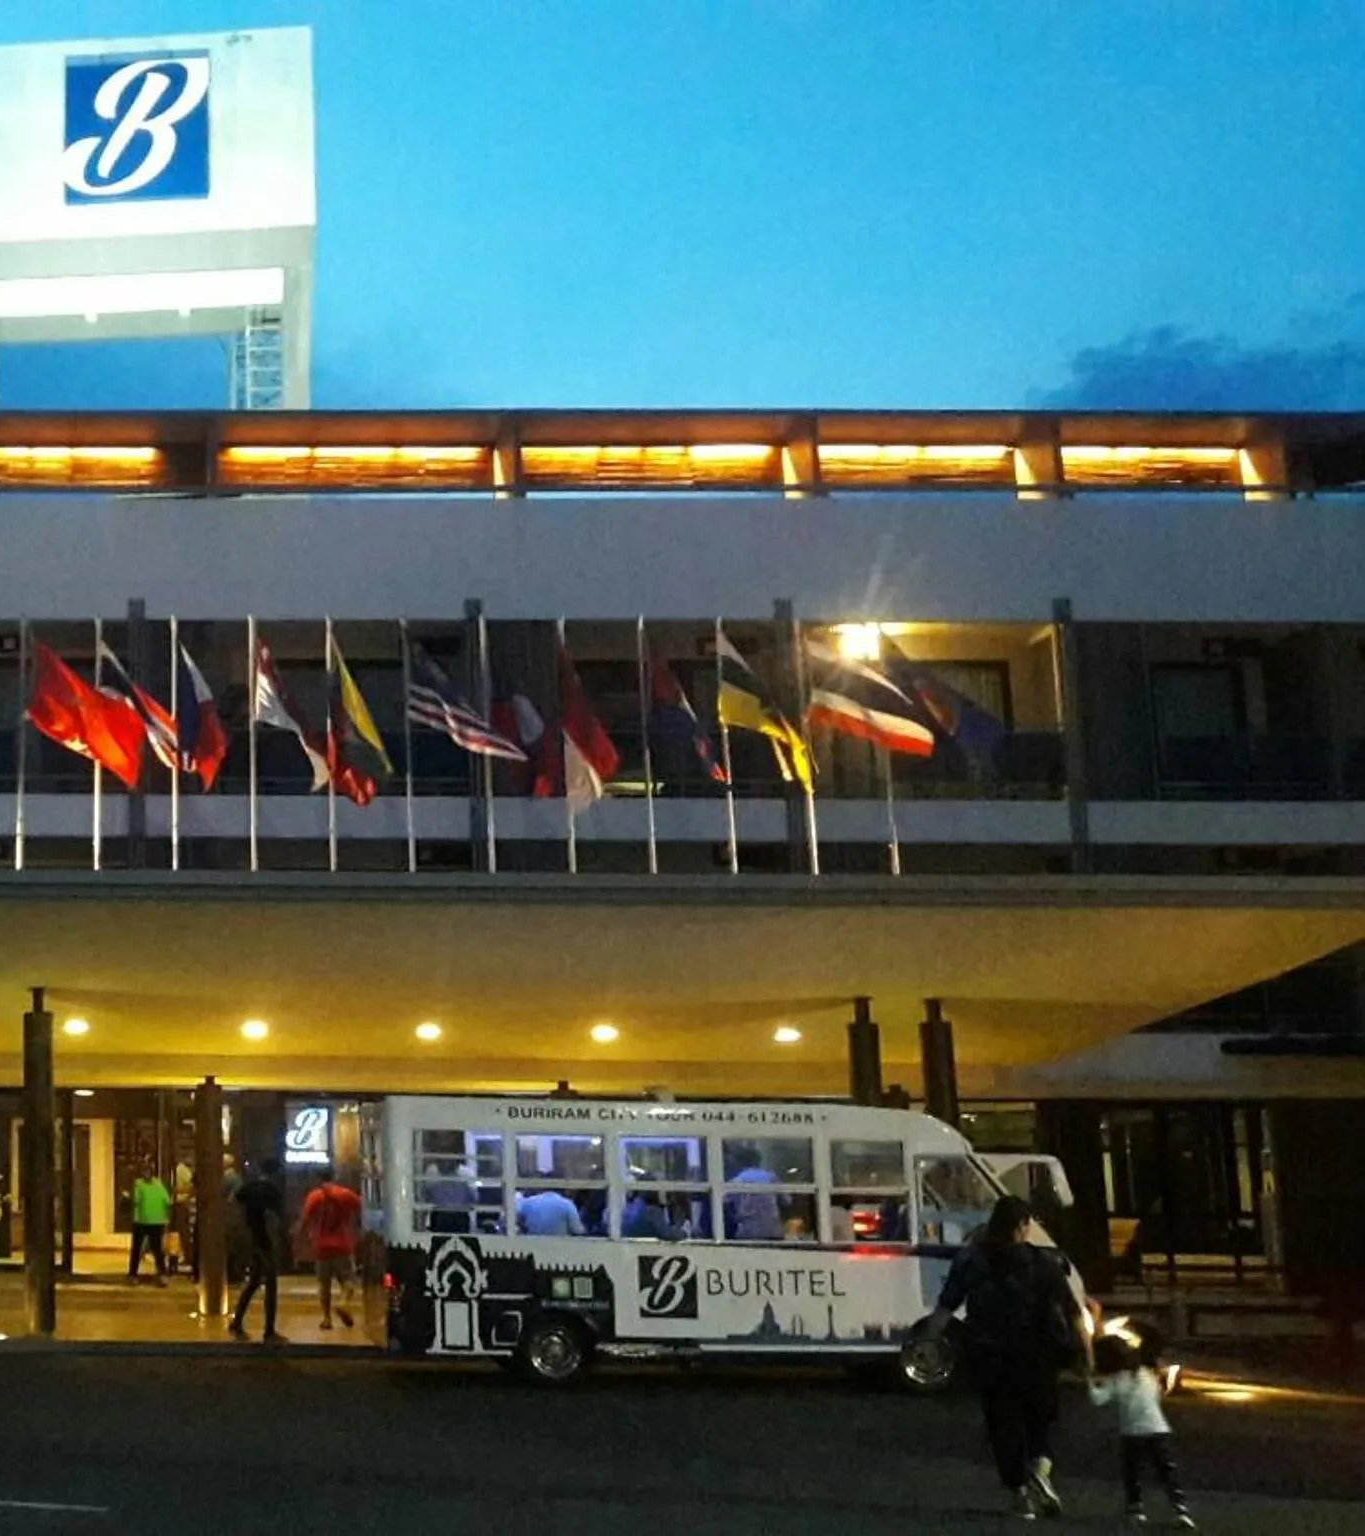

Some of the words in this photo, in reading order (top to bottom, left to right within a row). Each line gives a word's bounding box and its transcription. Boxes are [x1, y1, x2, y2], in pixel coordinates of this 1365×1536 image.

[62, 57, 209, 196] B
[285, 1107, 328, 1149] B
[507, 1106, 591, 1120] BURIRAM
[639, 1255, 696, 1314] B
[706, 1269, 847, 1297] BURITEL
